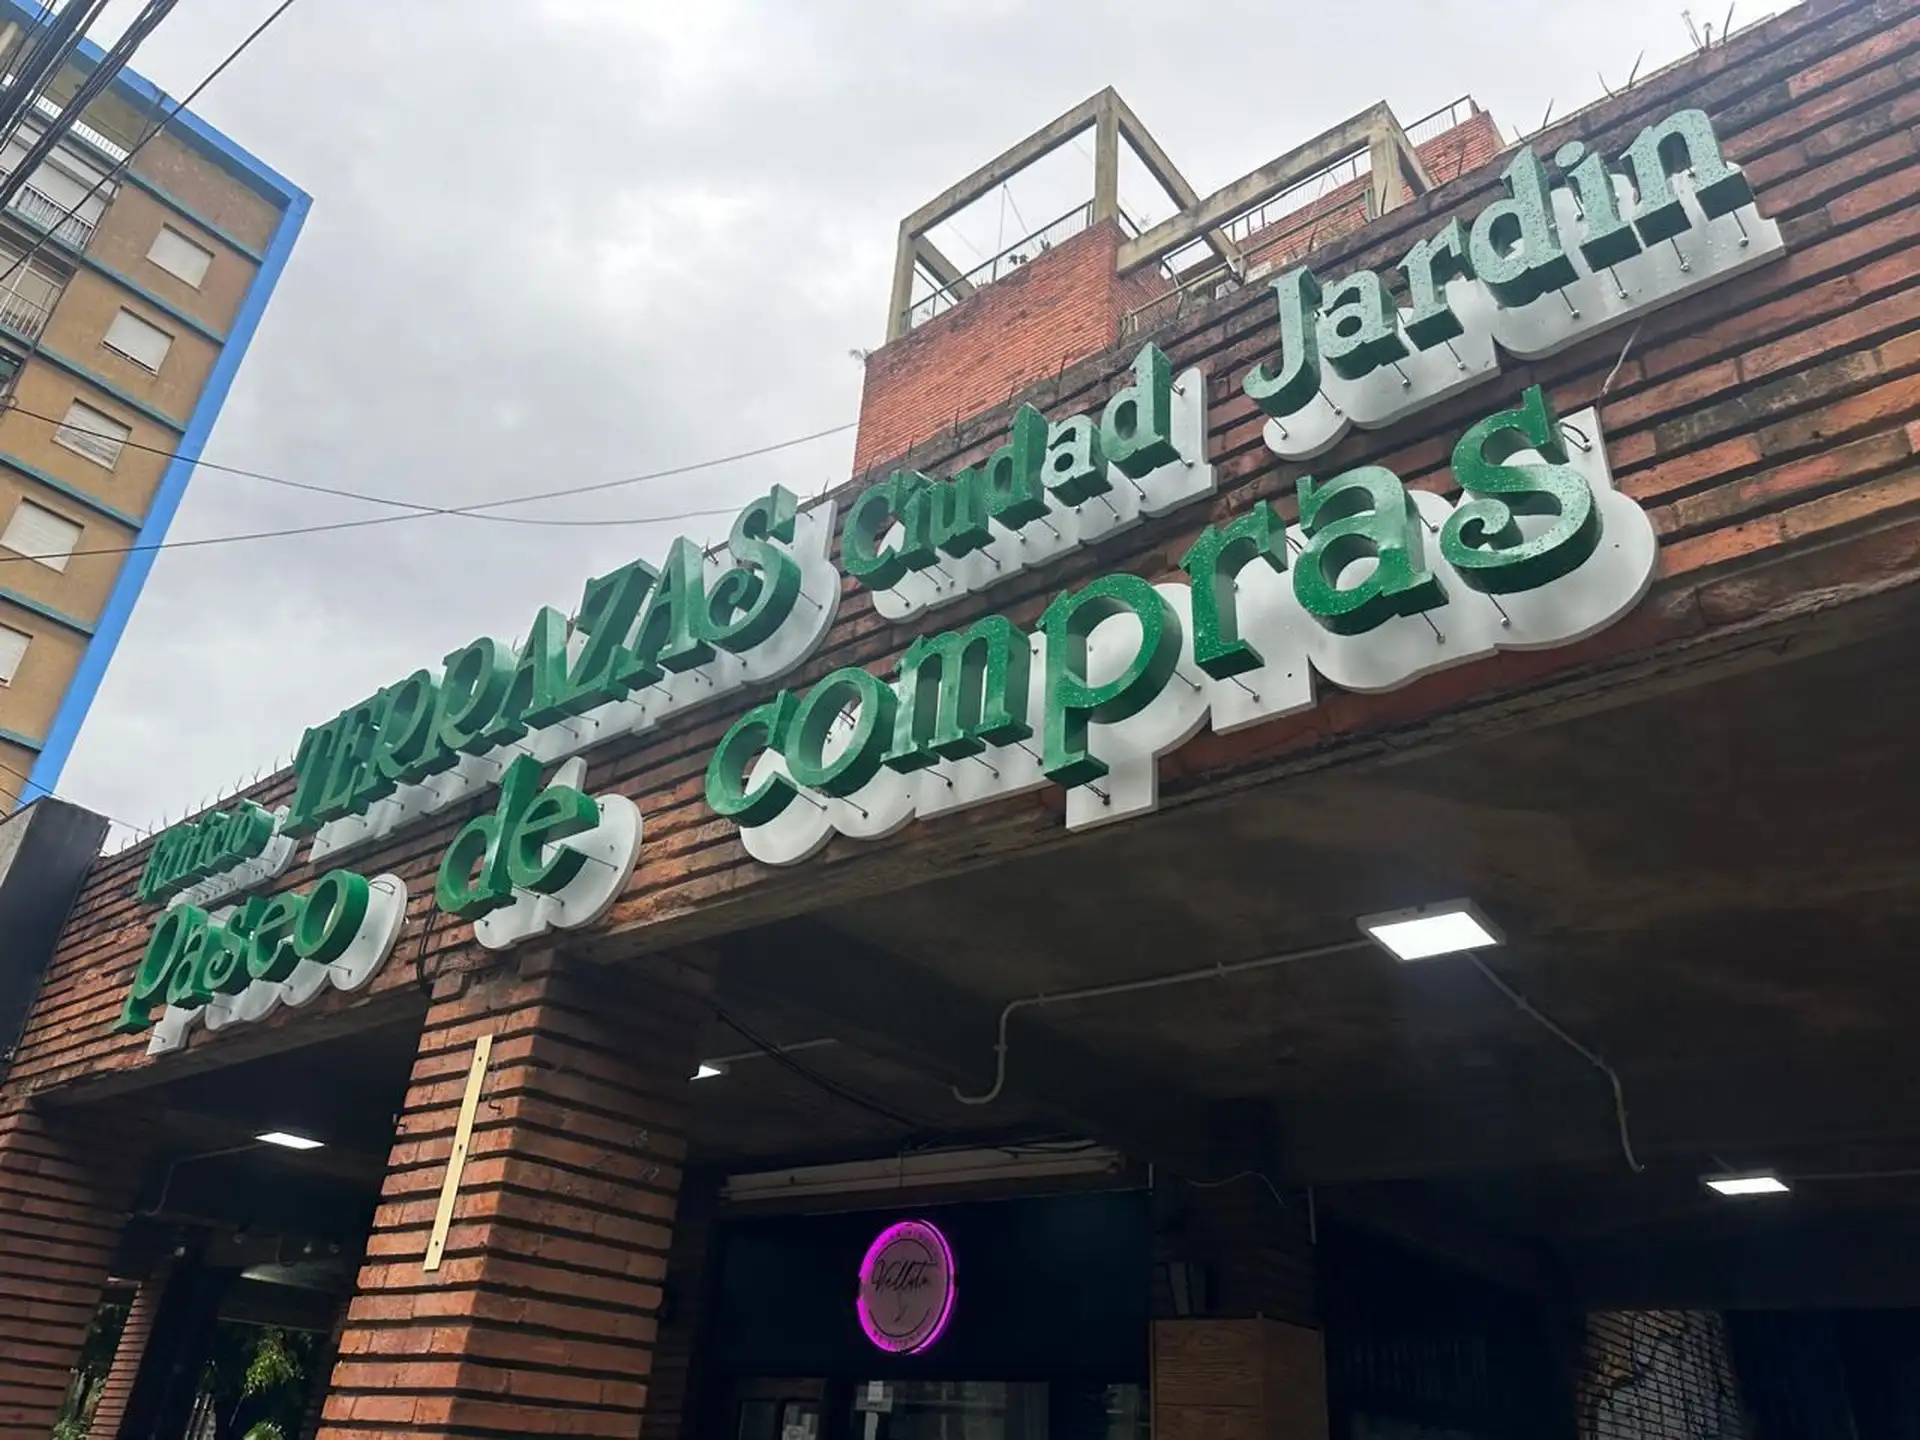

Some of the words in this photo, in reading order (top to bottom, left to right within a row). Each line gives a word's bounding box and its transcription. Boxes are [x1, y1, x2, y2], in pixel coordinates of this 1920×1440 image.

[113, 869, 369, 1033] Paseo
[437, 753, 599, 920] de
[706, 383, 1603, 828] compras
[279, 483, 800, 837] TERRAZAS
[842, 341, 1181, 591] Ciudad
[1242, 108, 1754, 416] Jardin
